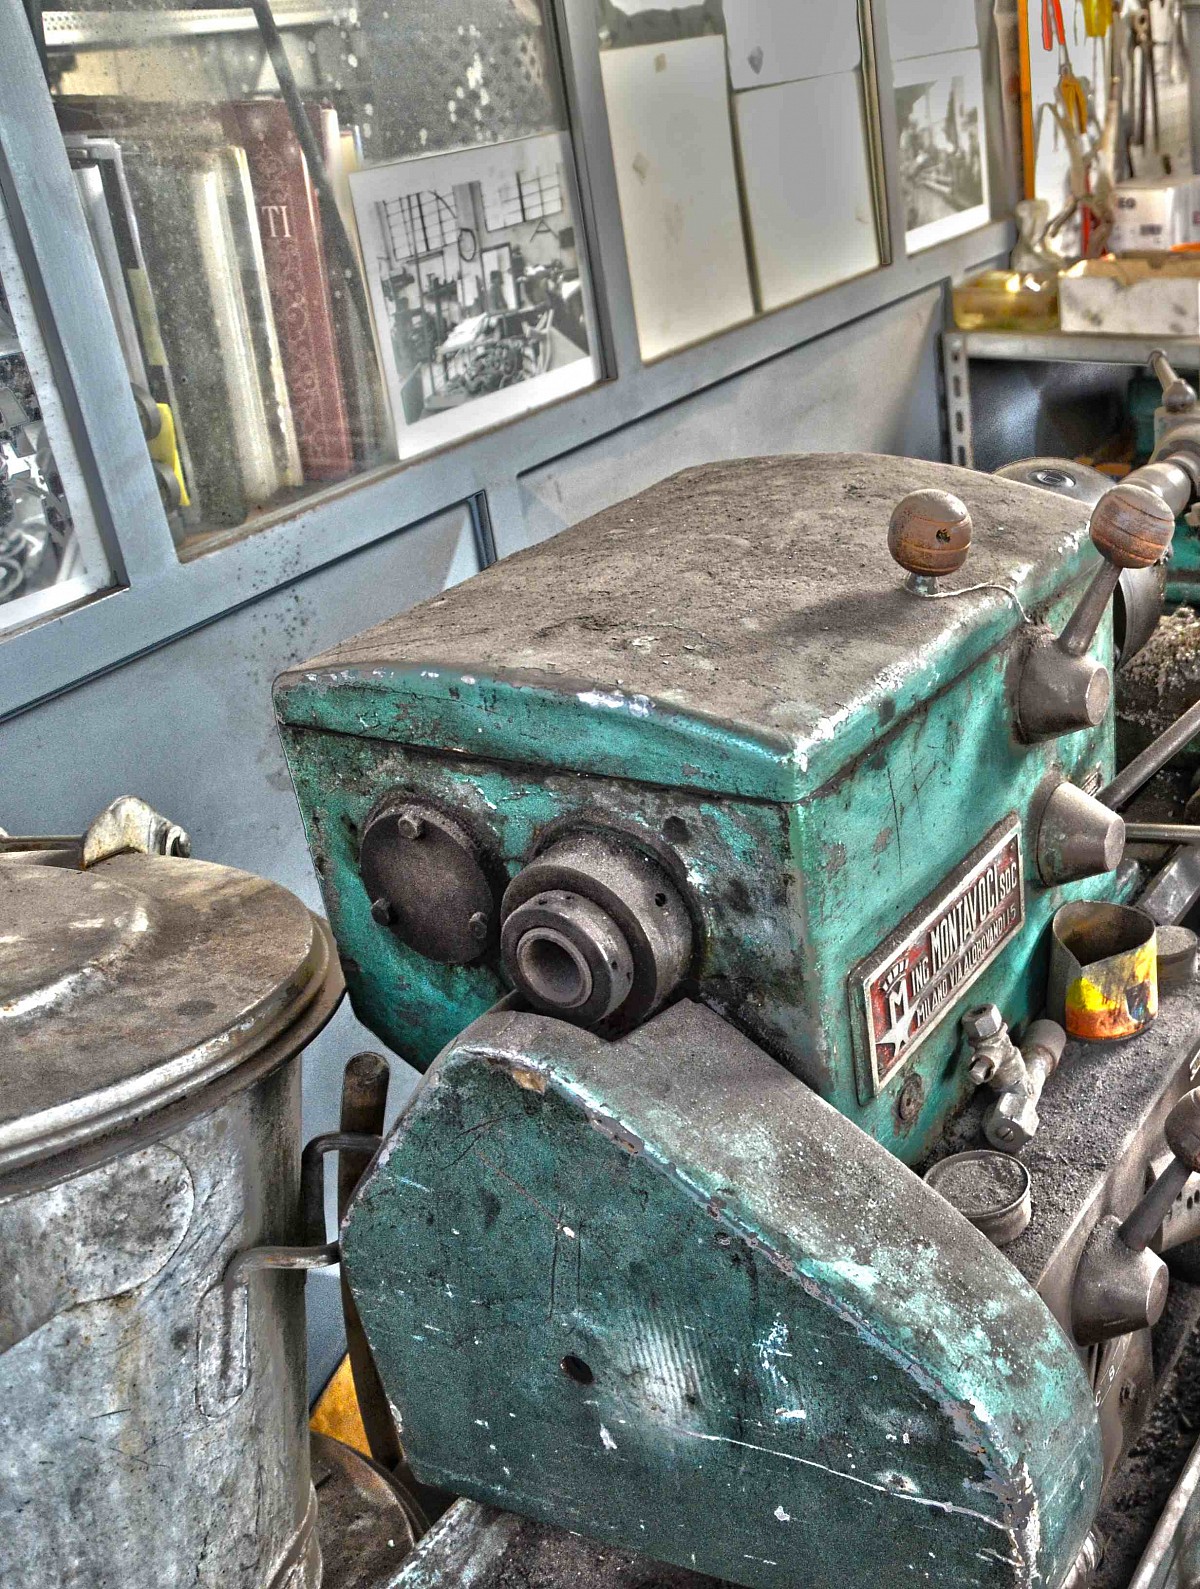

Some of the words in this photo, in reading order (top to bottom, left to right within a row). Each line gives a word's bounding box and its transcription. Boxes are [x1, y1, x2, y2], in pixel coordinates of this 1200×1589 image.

[911, 956, 930, 996] ING
[931, 863, 999, 975] MONTAVOCI
[917, 978, 948, 1027] MILANO
[949, 961, 964, 988] VIA
